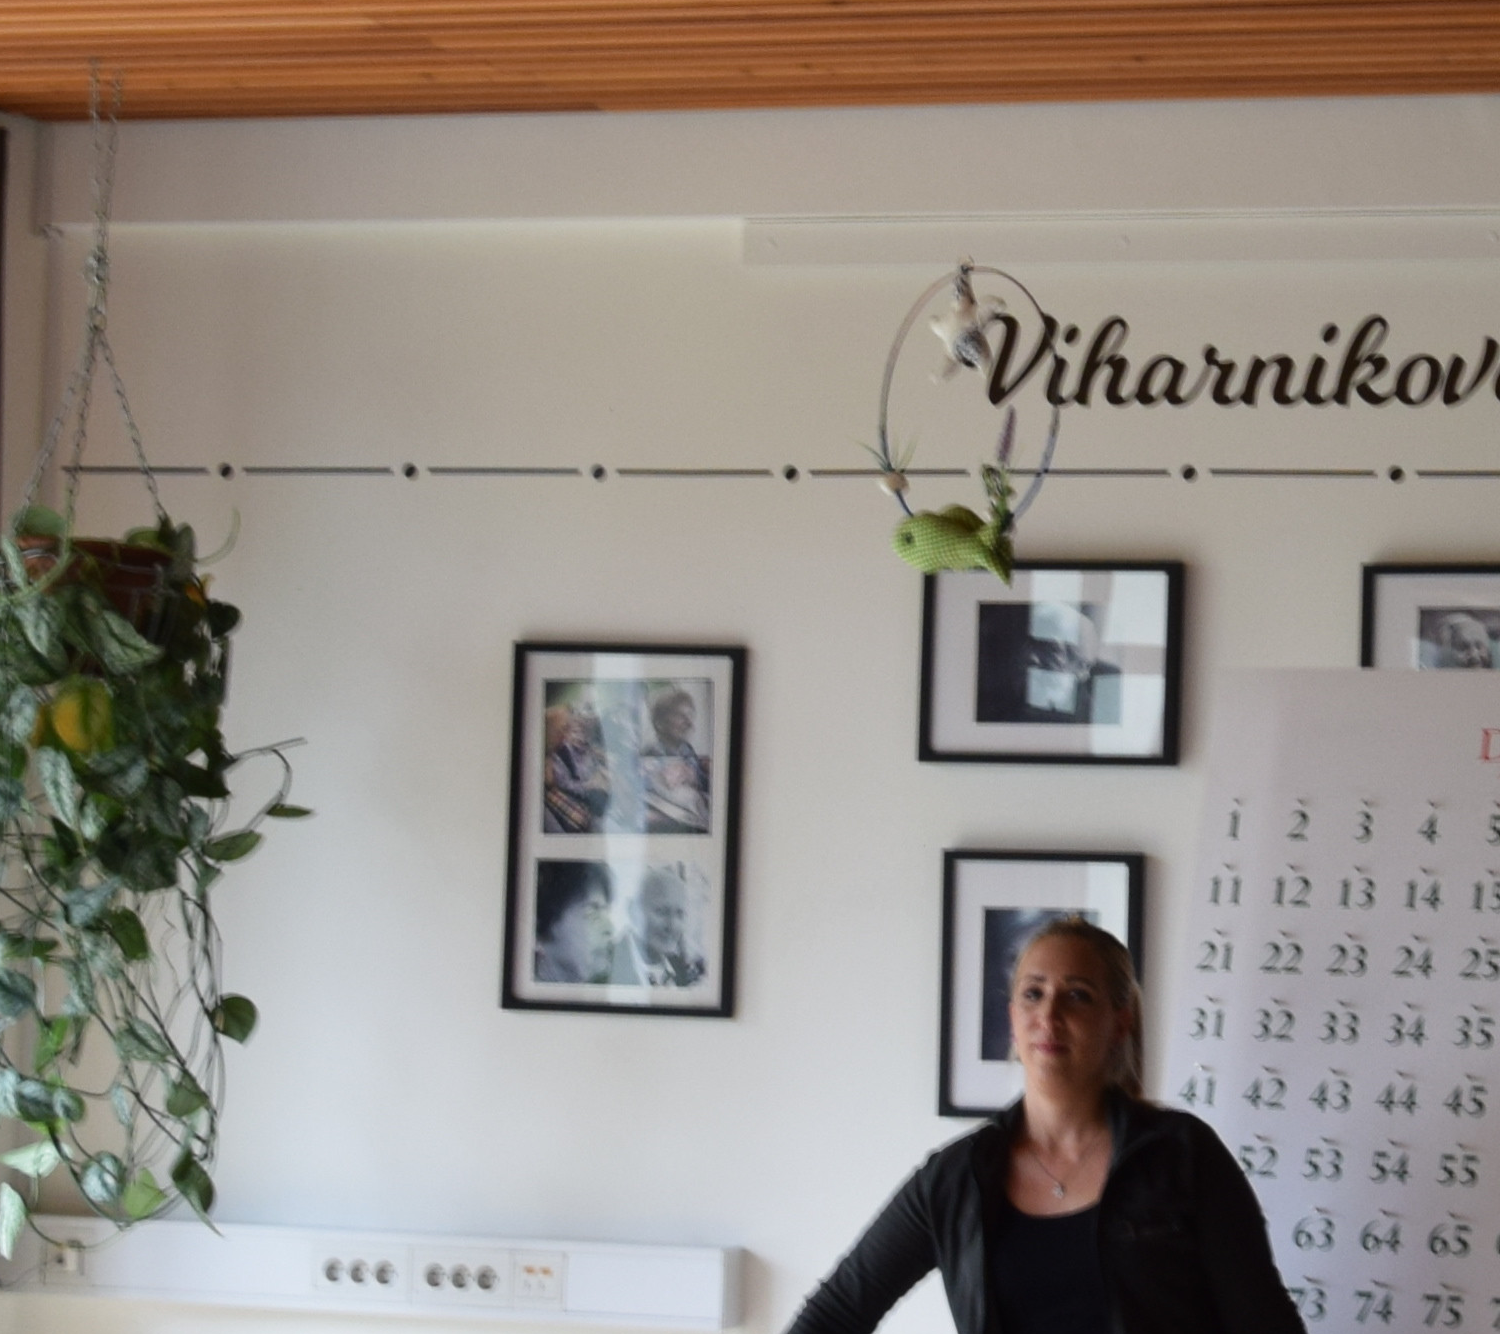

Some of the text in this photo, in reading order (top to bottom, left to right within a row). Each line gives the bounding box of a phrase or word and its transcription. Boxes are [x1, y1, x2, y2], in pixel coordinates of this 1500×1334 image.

[1227, 809, 1241, 841] 1
[1286, 809, 1310, 842] 2
[1354, 810, 1374, 844] 3
[1417, 813, 1441, 845] 4
[1208, 875, 1243, 907] 11
[1272, 875, 1313, 909] 12
[1338, 877, 1376, 910] 13
[1404, 879, 1444, 912] 14
[1195, 940, 1234, 973] 21
[1259, 941, 1305, 976] 22
[1325, 944, 1368, 977] 23
[1391, 945, 1436, 980] 24
[1189, 1007, 1226, 1040] 31
[1252, 1008, 1297, 1043] 32
[1318, 1011, 1360, 1045] 33
[1385, 1013, 1429, 1047] 34
[1452, 1015, 1496, 1050] 35
[1179, 1075, 1217, 1108] 41
[1242, 1076, 1288, 1111] 42
[1308, 1079, 1352, 1113] 43
[1374, 1082, 1421, 1117] 44
[1442, 1083, 1488, 1120] 45
[1239, 1144, 1279, 1180] 52
[1302, 1147, 1345, 1183] 53
[1369, 1150, 1414, 1186] 54
[1436, 1153, 1481, 1188] 55
[1292, 1217, 1337, 1252] 63
[1359, 1219, 1406, 1255] 64
[1426, 1223, 1473, 1258] 65
[1355, 1289, 1398, 1325] 74
[1421, 1293, 1465, 1330] 75
